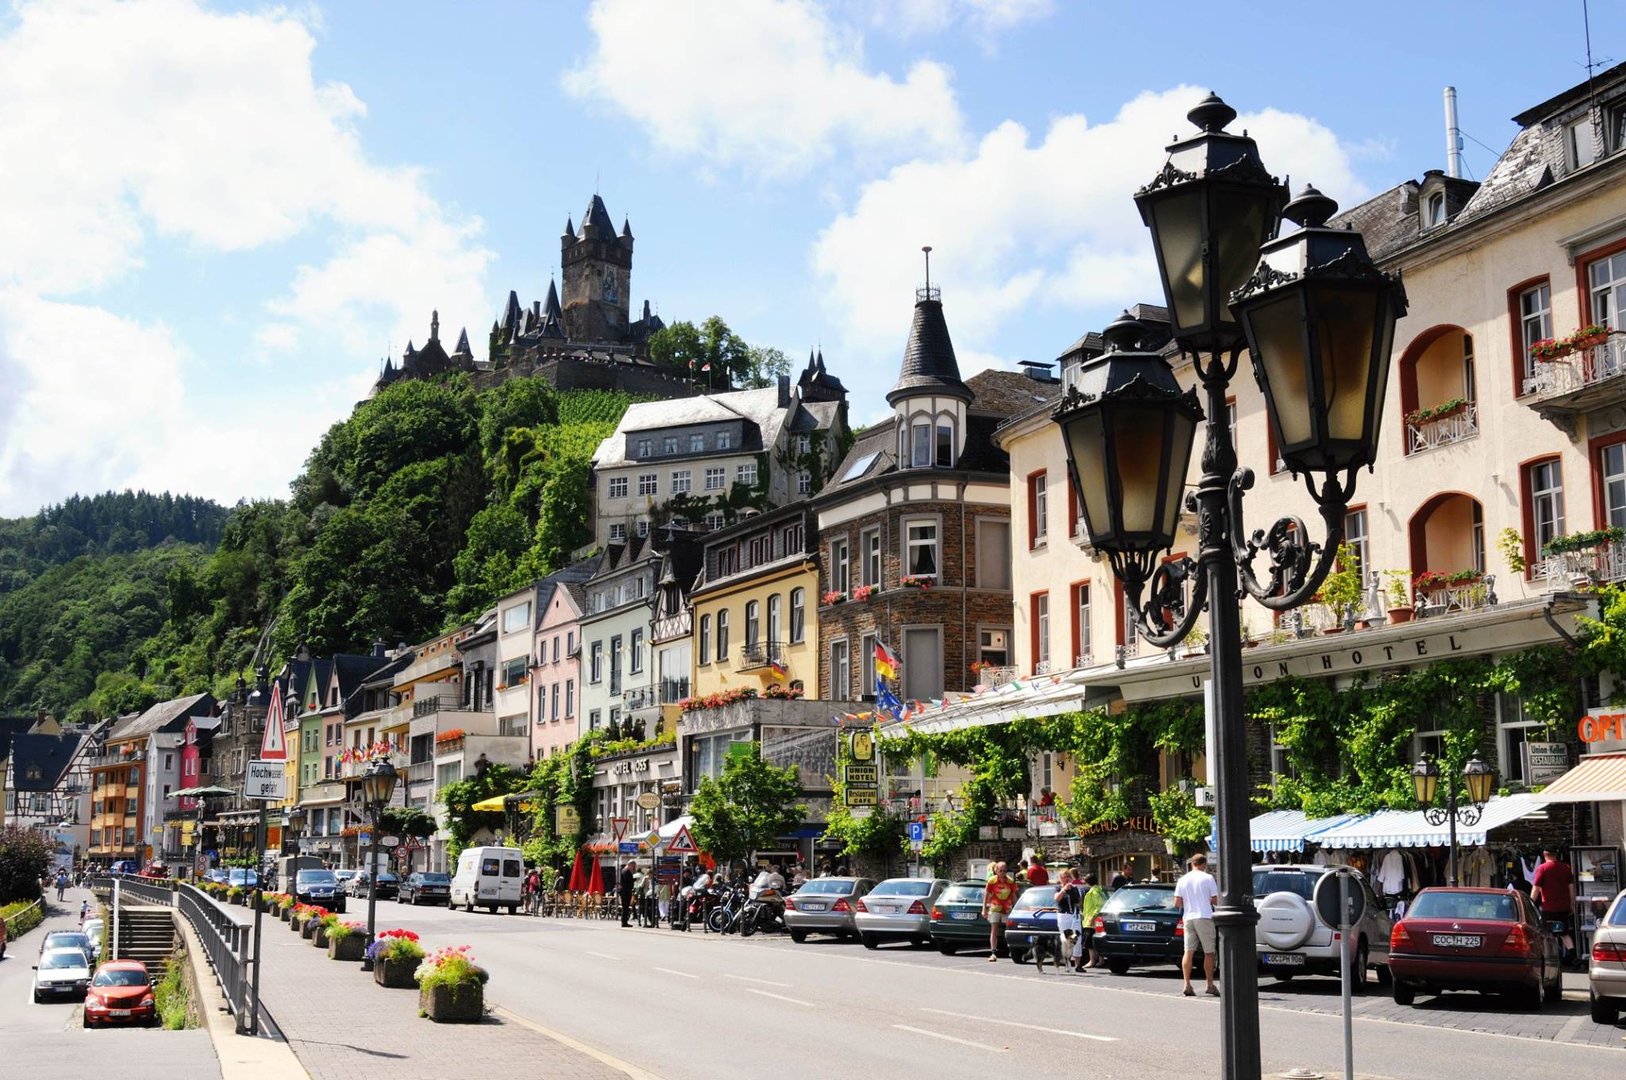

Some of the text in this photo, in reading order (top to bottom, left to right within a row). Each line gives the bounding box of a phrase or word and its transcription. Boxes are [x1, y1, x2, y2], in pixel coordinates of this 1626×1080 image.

[1192, 636, 1462, 689] UON HOTEL
[912, 825, 920, 839] P
